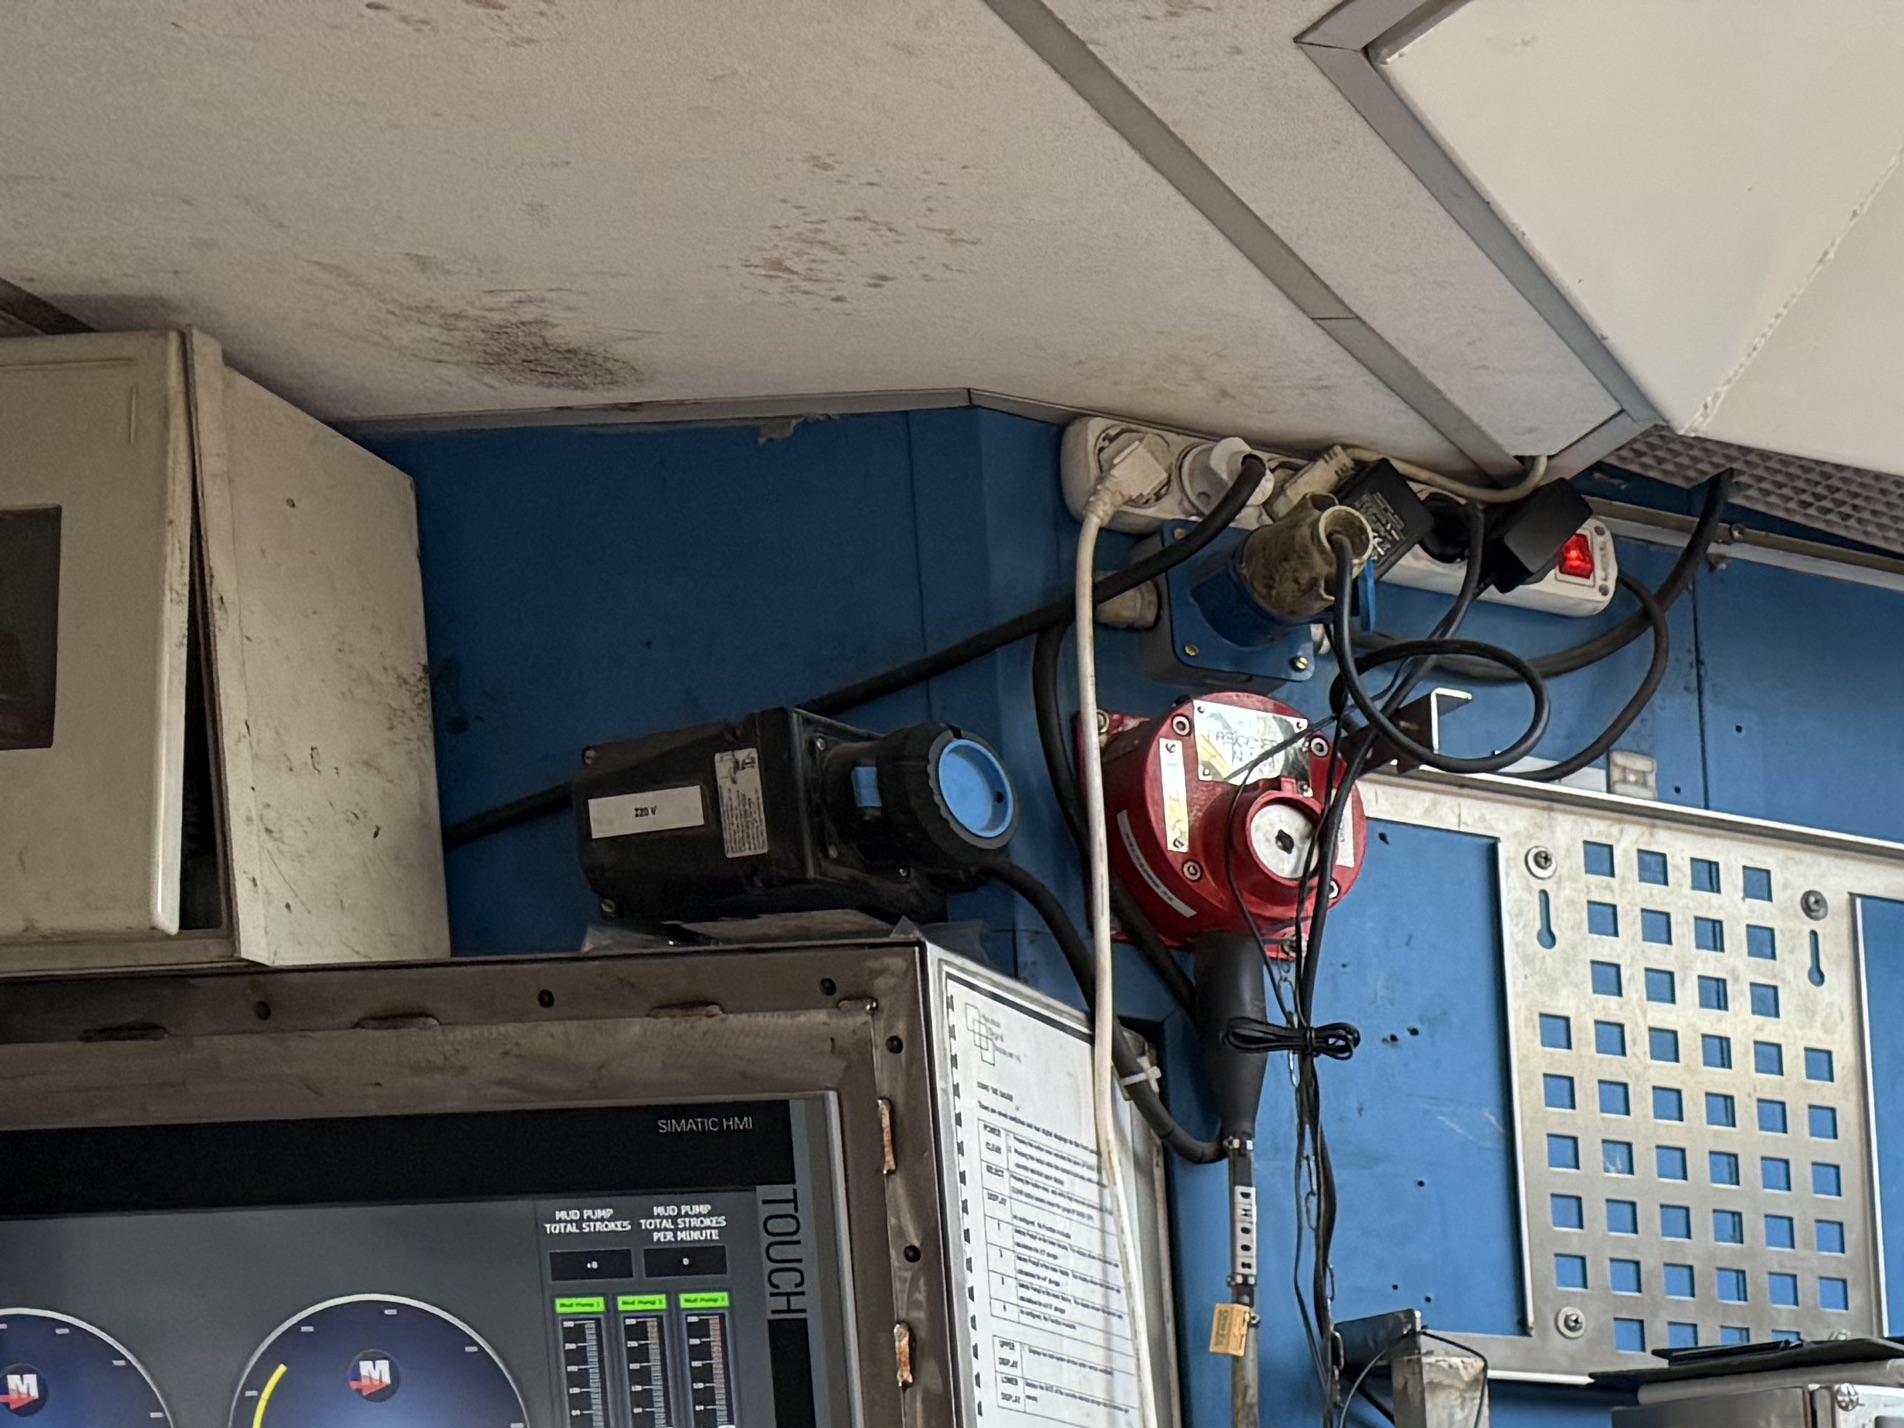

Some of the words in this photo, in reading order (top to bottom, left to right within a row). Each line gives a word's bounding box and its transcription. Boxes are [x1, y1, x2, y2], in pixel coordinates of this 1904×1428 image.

[657, 1117, 719, 1133] SIMATIC
[723, 1116, 753, 1130] HMI
[555, 1210, 580, 1220] MUD
[583, 1208, 613, 1219] PUMP
[653, 1205, 678, 1216] MUD
[681, 1204, 711, 1215] PUMP
[544, 1222, 580, 1234] TOTAL
[640, 1218, 674, 1230] TOTAL
[677, 1216, 727, 1228] STROKES
[653, 1231, 675, 1242] PER
[677, 1229, 719, 1241] MINUTE
[761, 1187, 807, 1315] TOUCH
